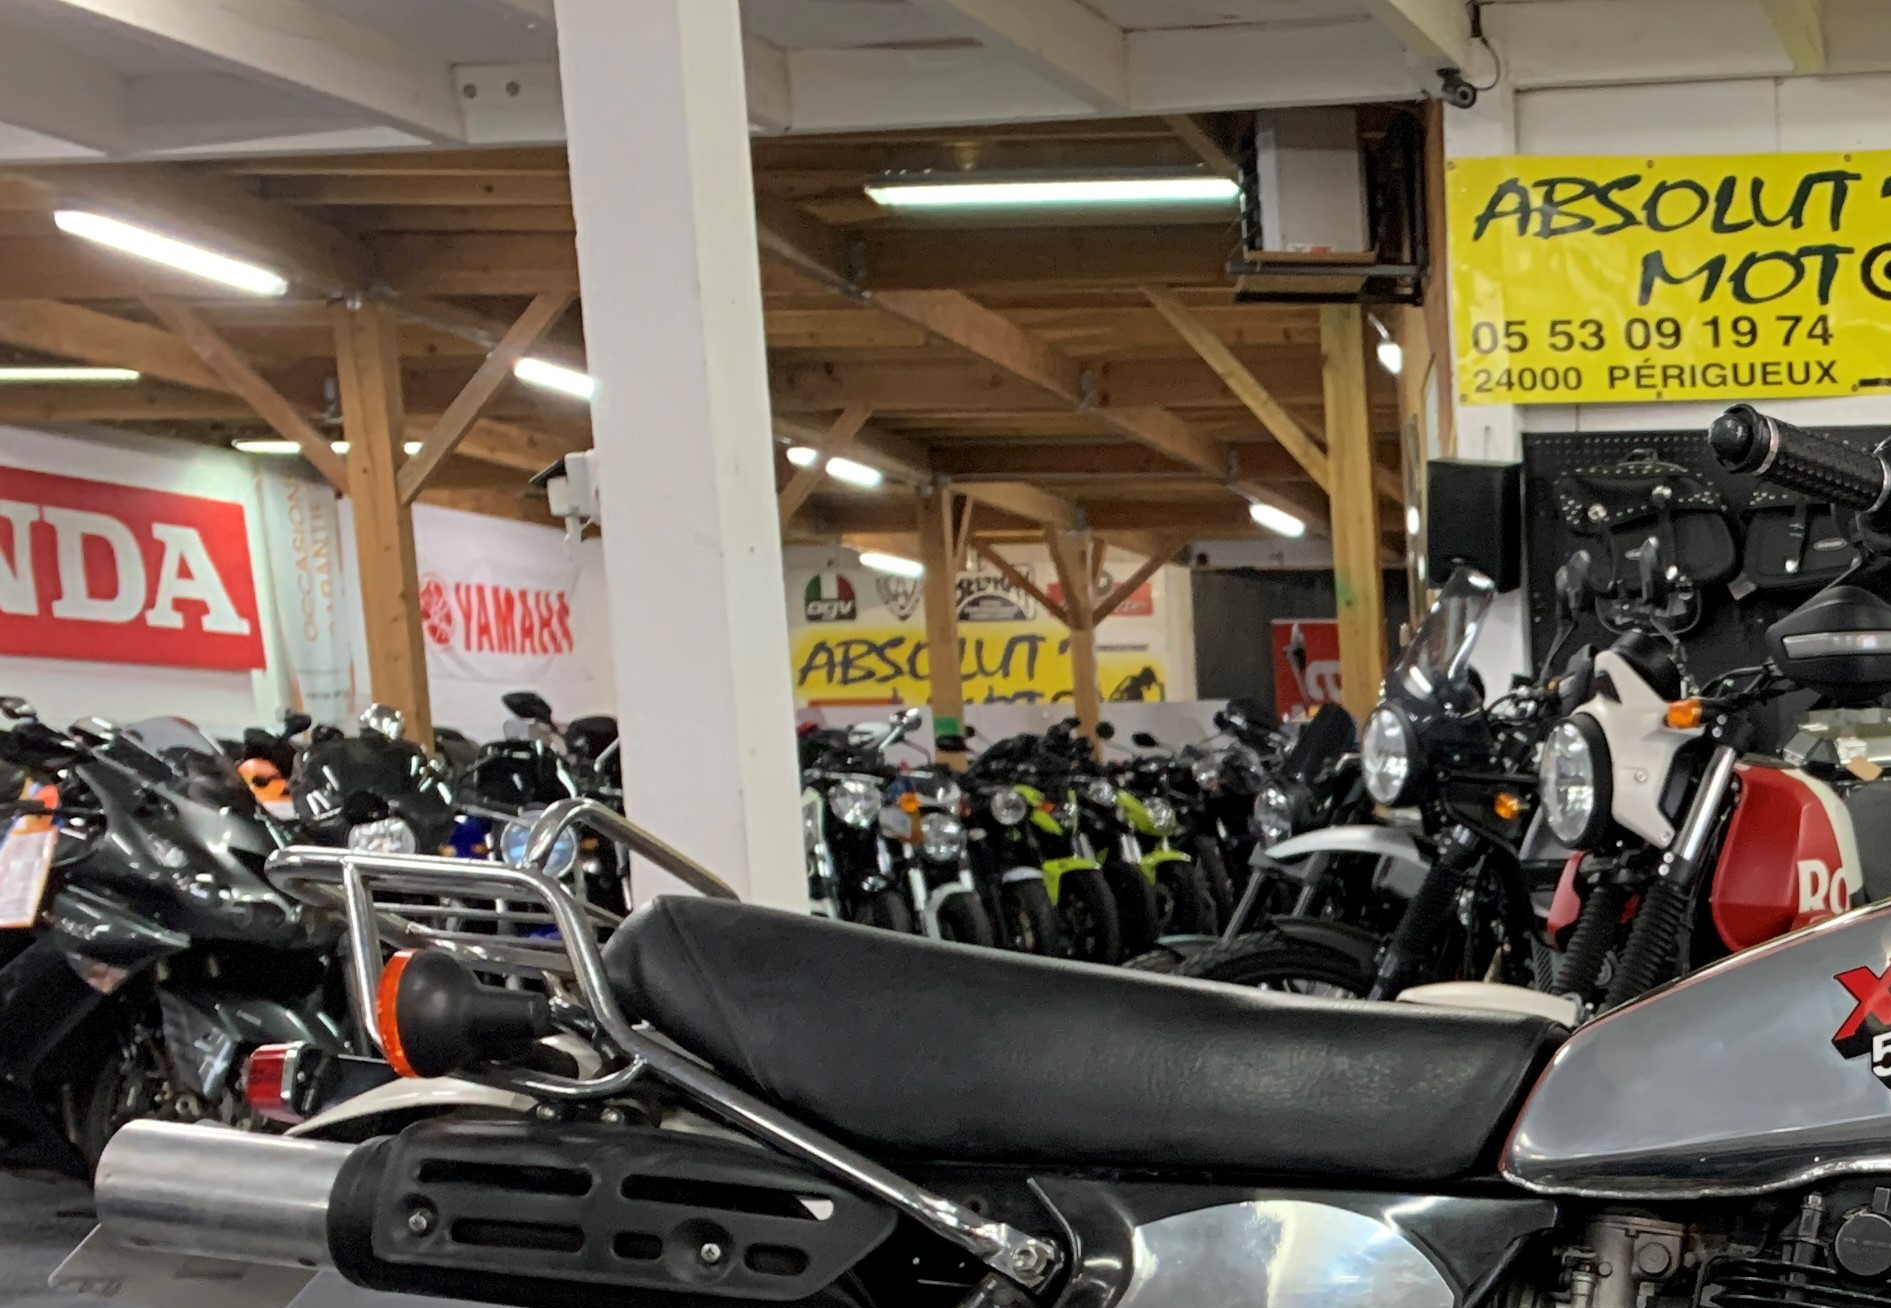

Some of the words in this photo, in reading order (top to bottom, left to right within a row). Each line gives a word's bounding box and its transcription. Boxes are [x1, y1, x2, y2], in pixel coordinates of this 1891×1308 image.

[1472, 318, 1529, 355] 05
[1548, 318, 1606, 352] 53
[1624, 316, 1682, 351] 09
[1702, 314, 1758, 350] 19
[1775, 313, 1834, 348] 74
[1474, 365, 1583, 393] 24000
[1607, 359, 1839, 390] PÉRIGUEUX
[454, 581, 574, 656] YAMAHA
